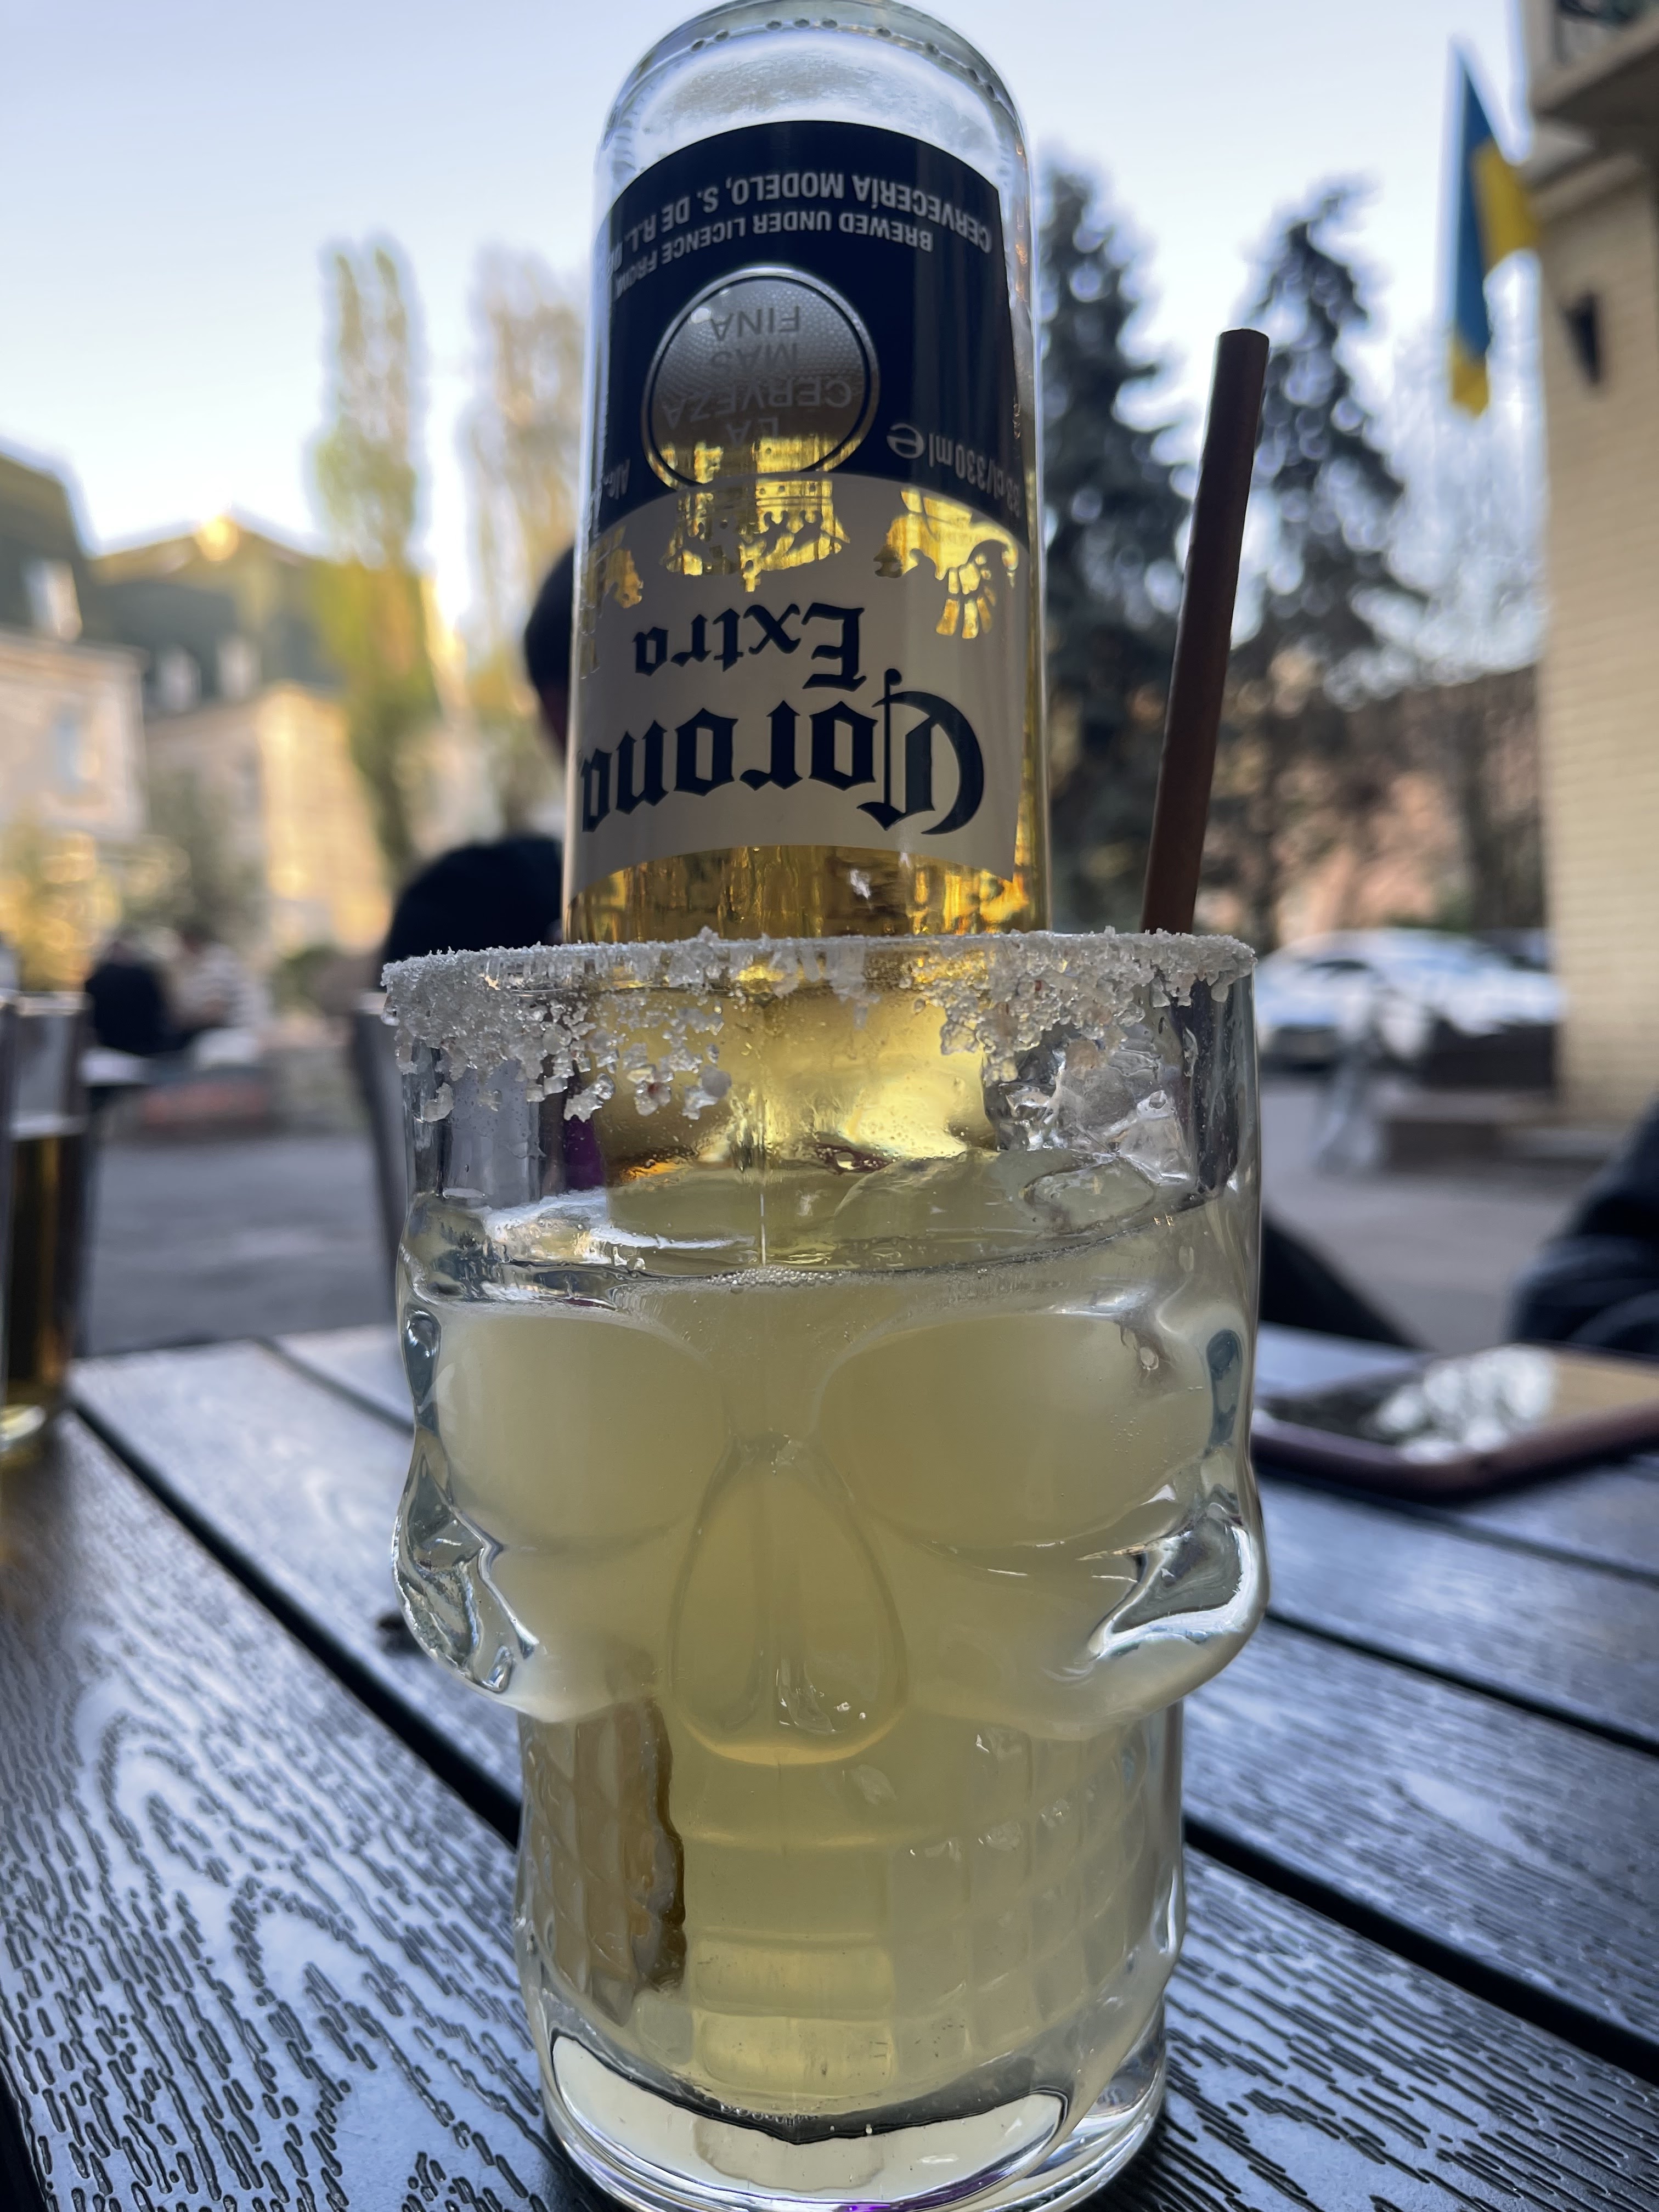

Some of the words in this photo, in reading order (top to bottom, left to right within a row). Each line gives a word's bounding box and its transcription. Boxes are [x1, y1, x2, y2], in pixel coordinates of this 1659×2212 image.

[696, 186, 719, 213] S.
[725, 171, 845, 206] MODELO,
[623, 214, 657, 252] R.L.
[661, 196, 691, 233] DE
[753, 211, 833, 235] UNDER
[838, 212, 933, 253] BREWED
[851, 174, 992, 253] CERVECERÍA
[661, 217, 746, 265] LICENCE
[612, 249, 658, 302] FROM
[711, 306, 801, 342] FINA
[661, 379, 853, 431] CERVEZA
[726, 415, 780, 449] LA
[633, 602, 867, 691] Extra
[581, 668, 984, 835] Corona
